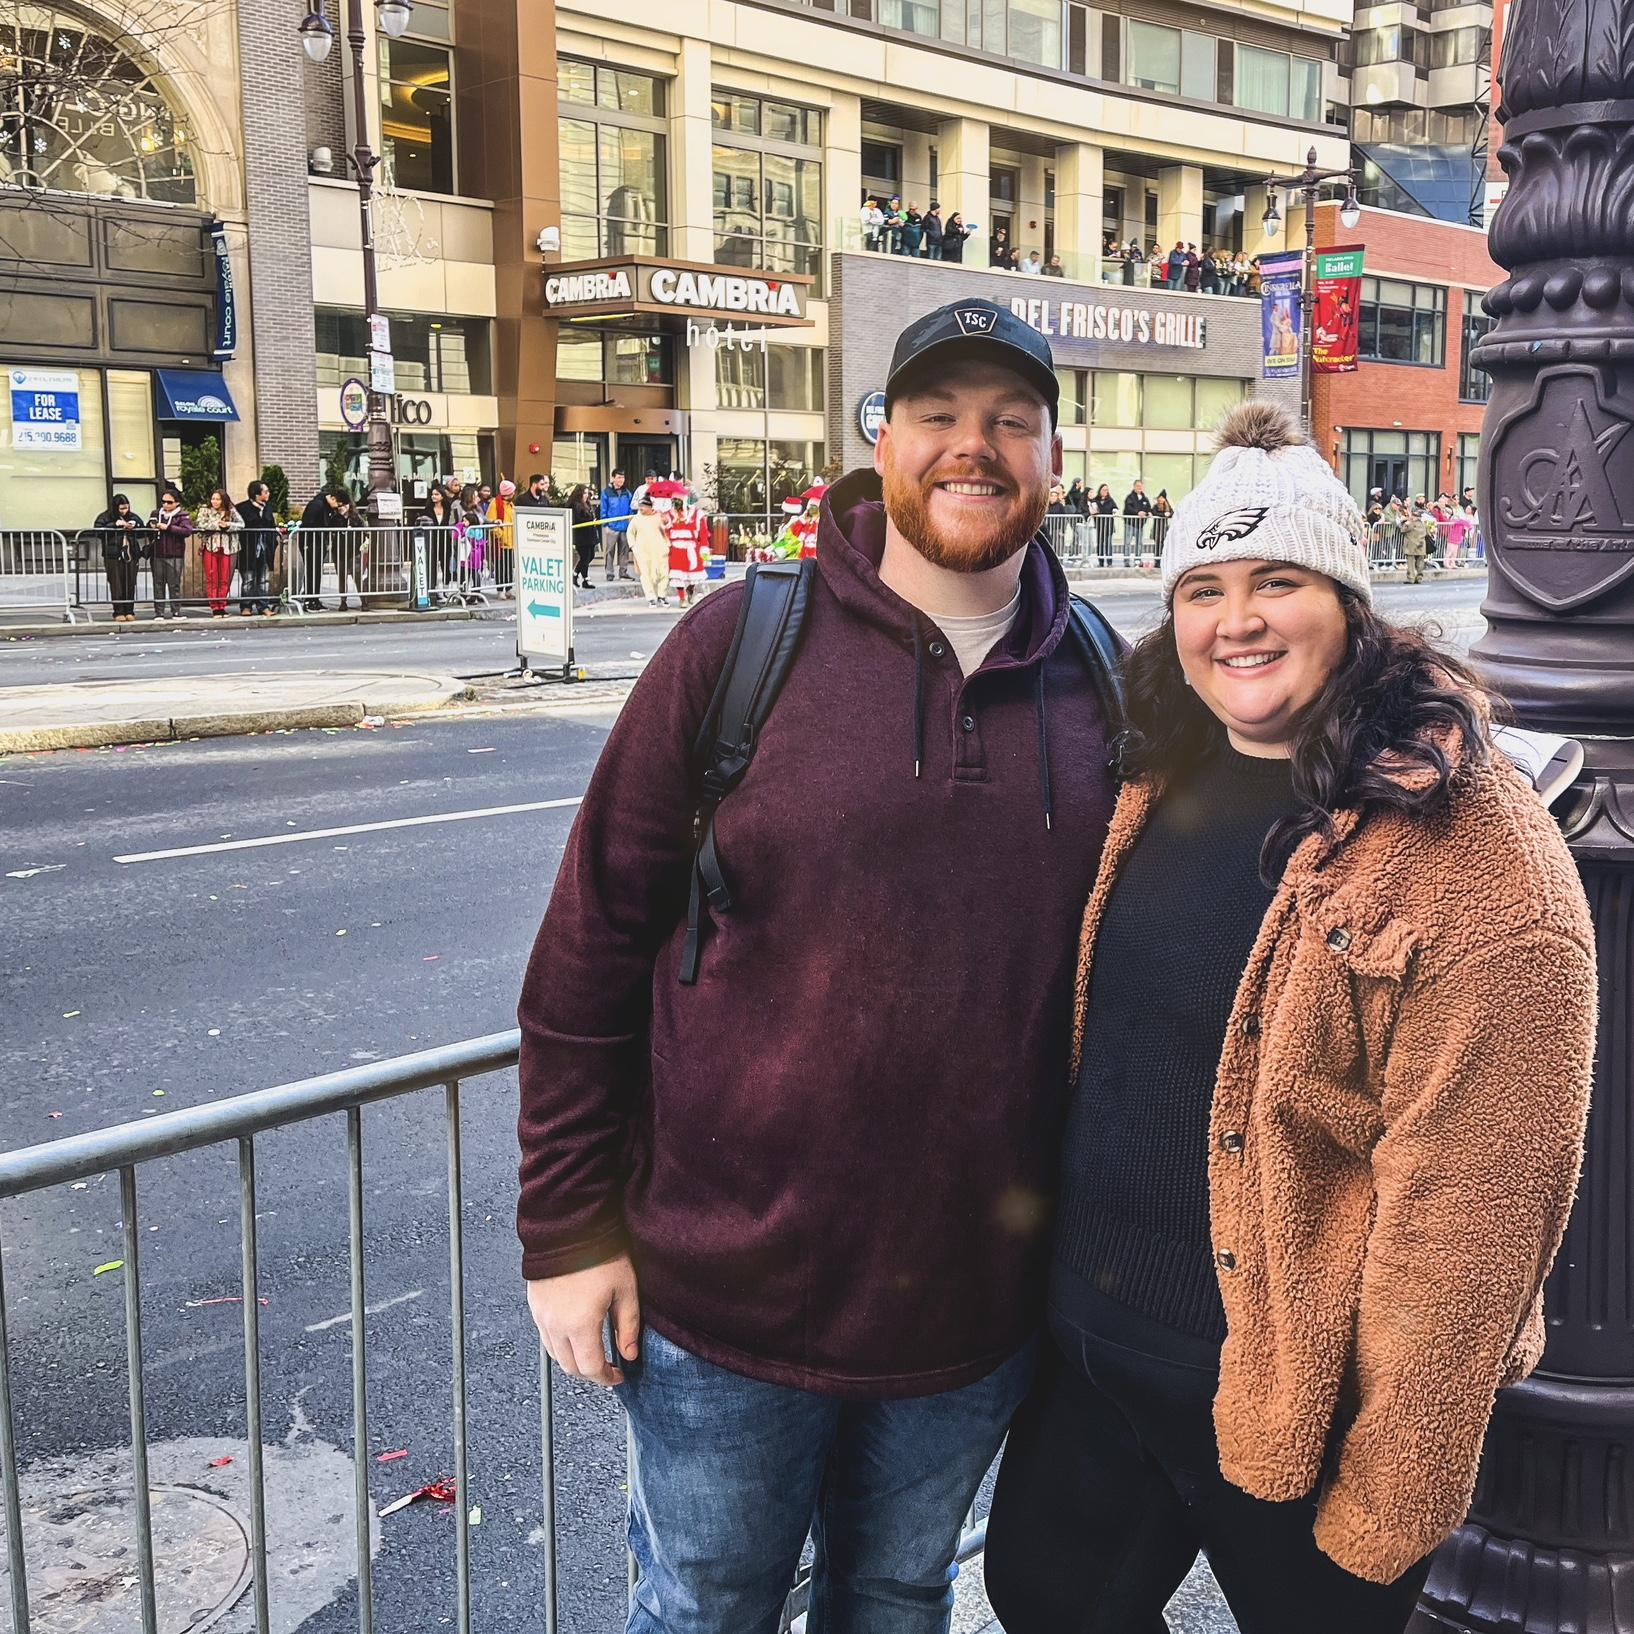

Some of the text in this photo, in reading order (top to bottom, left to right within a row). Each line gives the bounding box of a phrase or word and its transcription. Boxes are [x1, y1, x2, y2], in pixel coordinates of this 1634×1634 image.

[1325, 261, 1354, 273] Ballet
[220, 256, 232, 347] royale court
[964, 312, 987, 328] TSC
[1060, 302, 1150, 343] FRISCO'S
[1154, 311, 1205, 349] GRILLE
[686, 318, 767, 353] hotel
[34, 393, 56, 407] FOR
[29, 407, 63, 421] LEASE
[206, 405, 233, 414] court
[417, 545, 425, 596] VALET
[522, 556, 563, 577] VALET
[522, 577, 564, 594] PARKING
